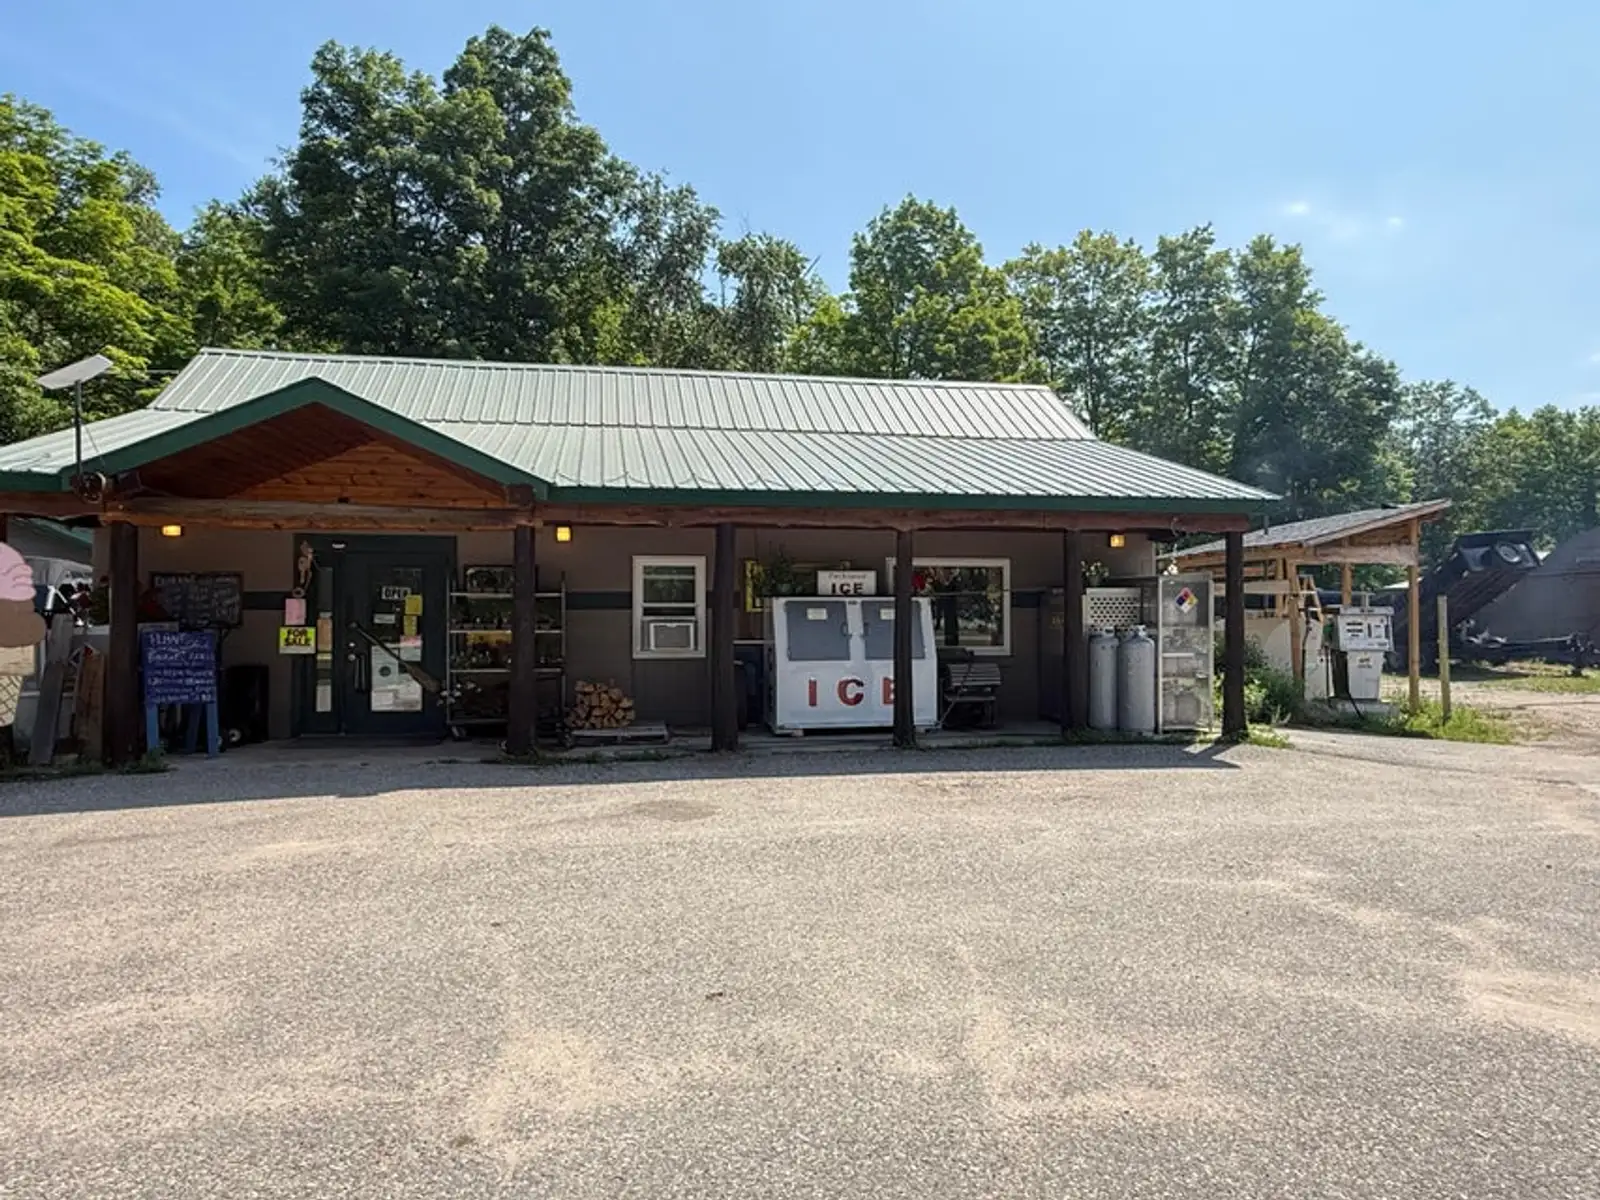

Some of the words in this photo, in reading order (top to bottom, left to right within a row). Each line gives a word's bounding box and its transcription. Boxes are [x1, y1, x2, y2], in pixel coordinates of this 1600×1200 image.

[831, 582, 864, 595] ICE
[287, 629, 307, 637] FOR
[284, 637, 312, 646] SALE
